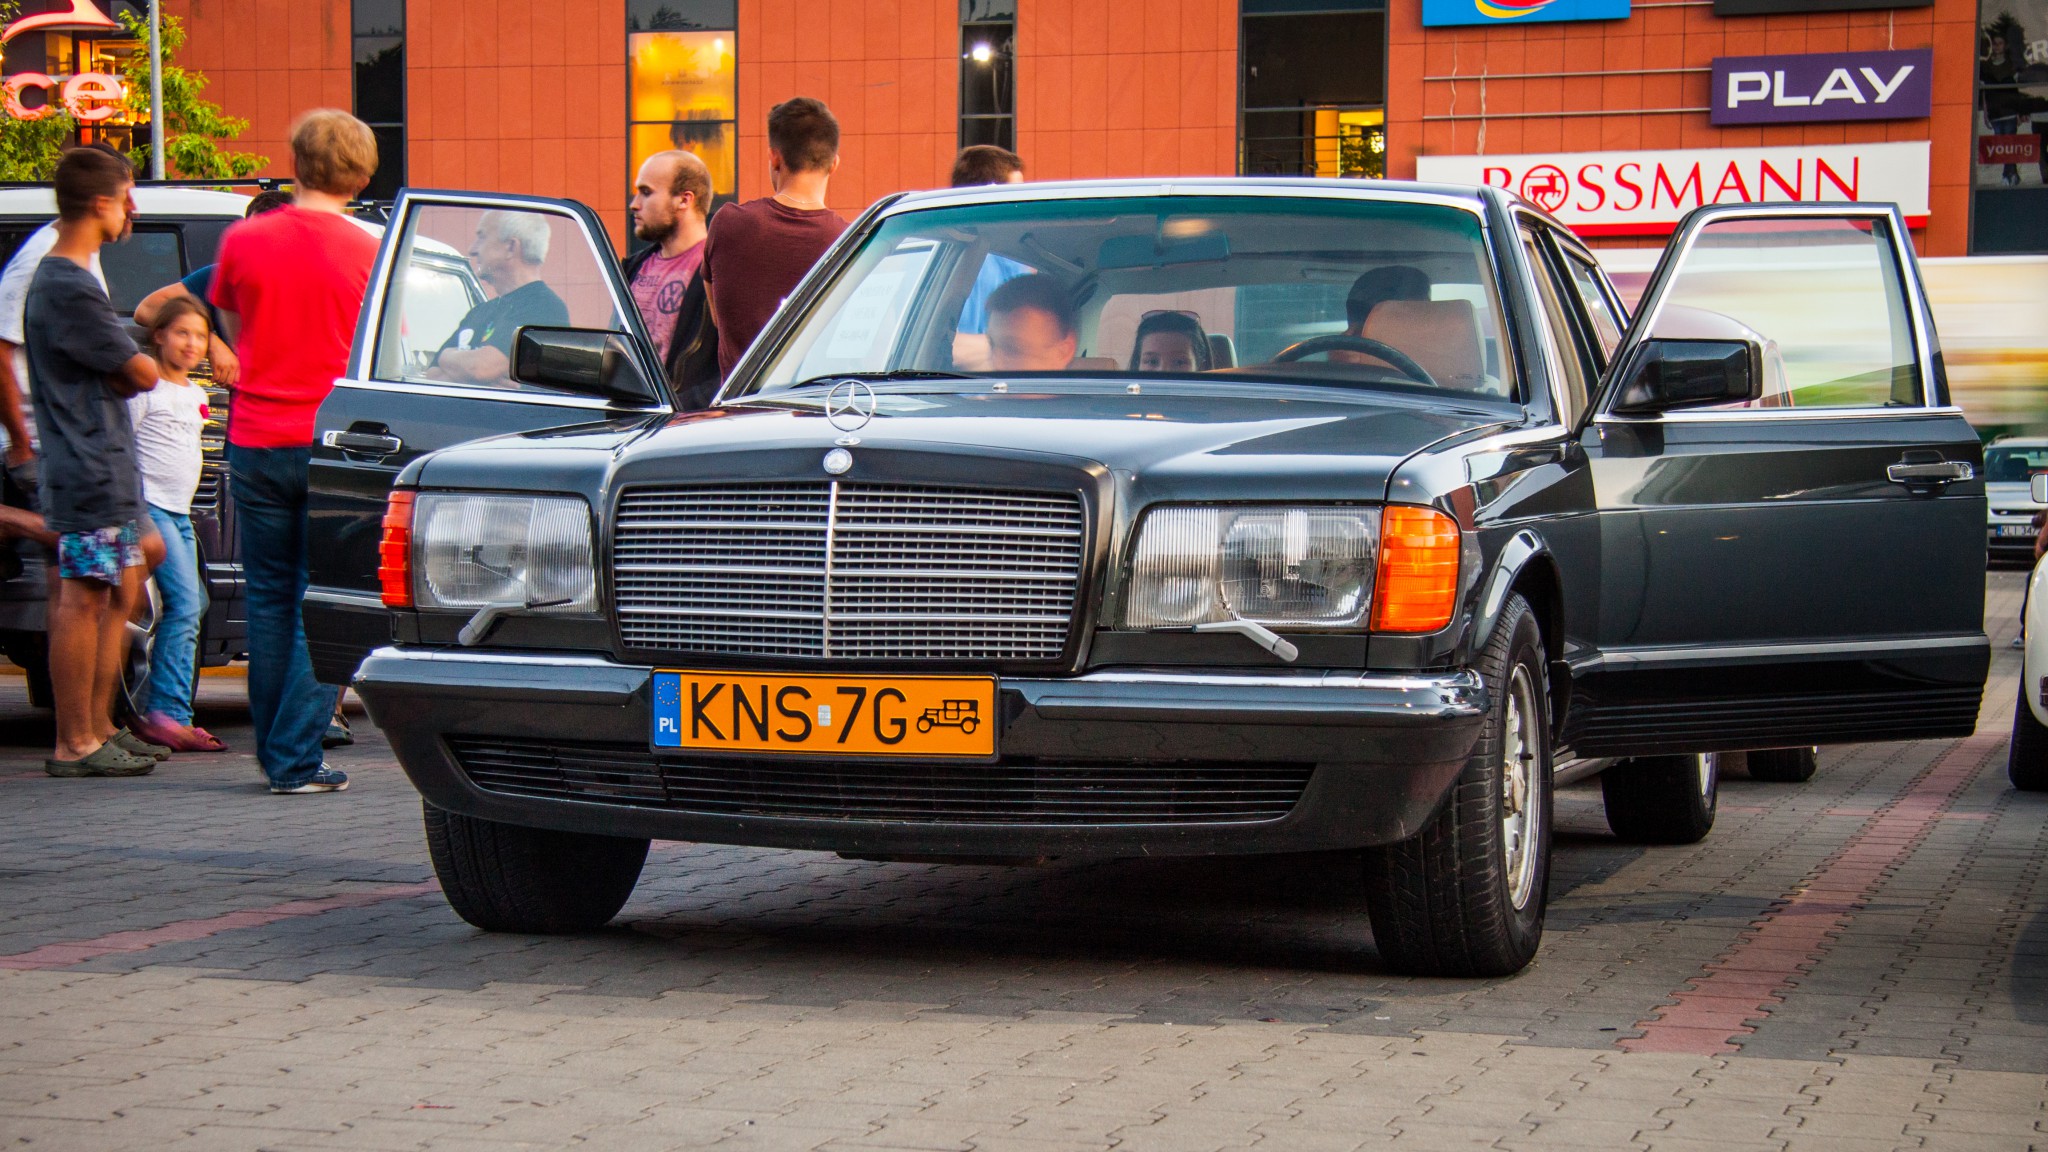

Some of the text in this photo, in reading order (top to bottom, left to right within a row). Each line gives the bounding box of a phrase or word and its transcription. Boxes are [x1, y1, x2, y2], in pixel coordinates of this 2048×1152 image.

[1727, 65, 1915, 108] PLAY
[1986, 144, 2033, 158] young
[659, 717, 678, 733] PL
[691, 682, 907, 745] KNS 7G
